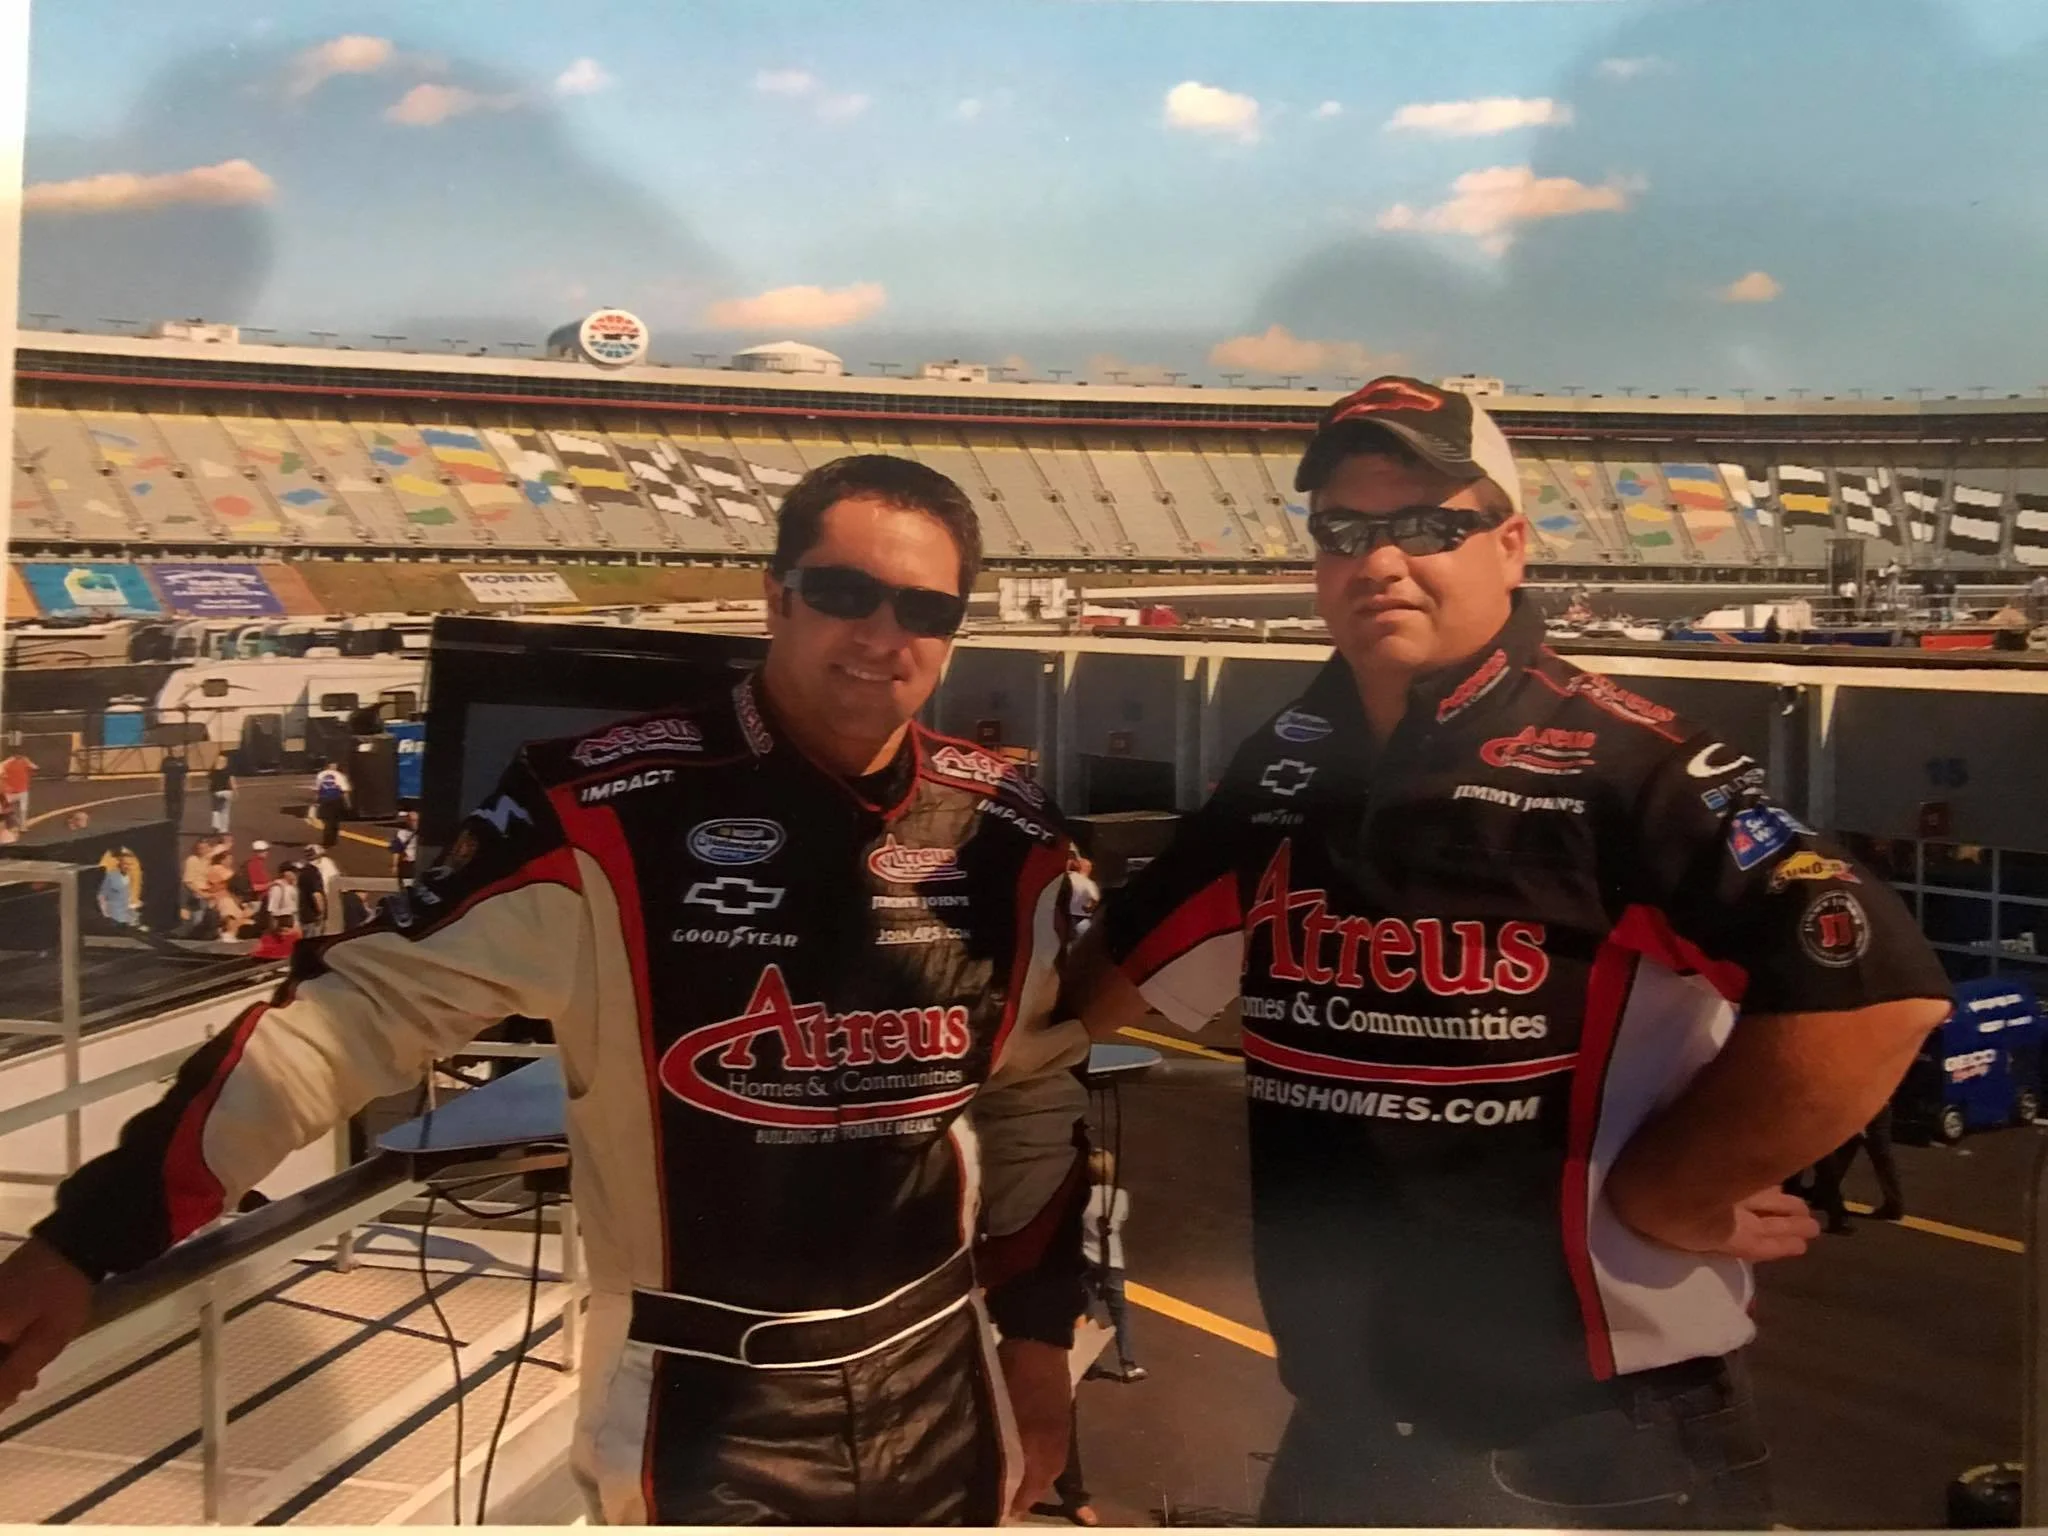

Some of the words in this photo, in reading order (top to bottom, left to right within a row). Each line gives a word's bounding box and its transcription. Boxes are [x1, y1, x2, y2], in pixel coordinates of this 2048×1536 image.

[581, 769, 675, 802] IMPACT
[1453, 785, 1521, 808] JIMMY
[1522, 796, 1586, 814] JOHN'S
[977, 798, 1055, 841] IMPACT
[1247, 838, 1550, 997] Atreus
[671, 926, 799, 948] GOODYEAR
[719, 963, 970, 1071] Atreus
[1240, 995, 1285, 1020] omes
[1292, 992, 1320, 1026] &
[1326, 995, 1548, 1041] Communities
[728, 1072, 804, 1099] Homes
[806, 1075, 830, 1098] &
[1246, 1075, 1542, 1126] TREUSHOMES.COM
[755, 1128, 817, 1145] BUILDING
